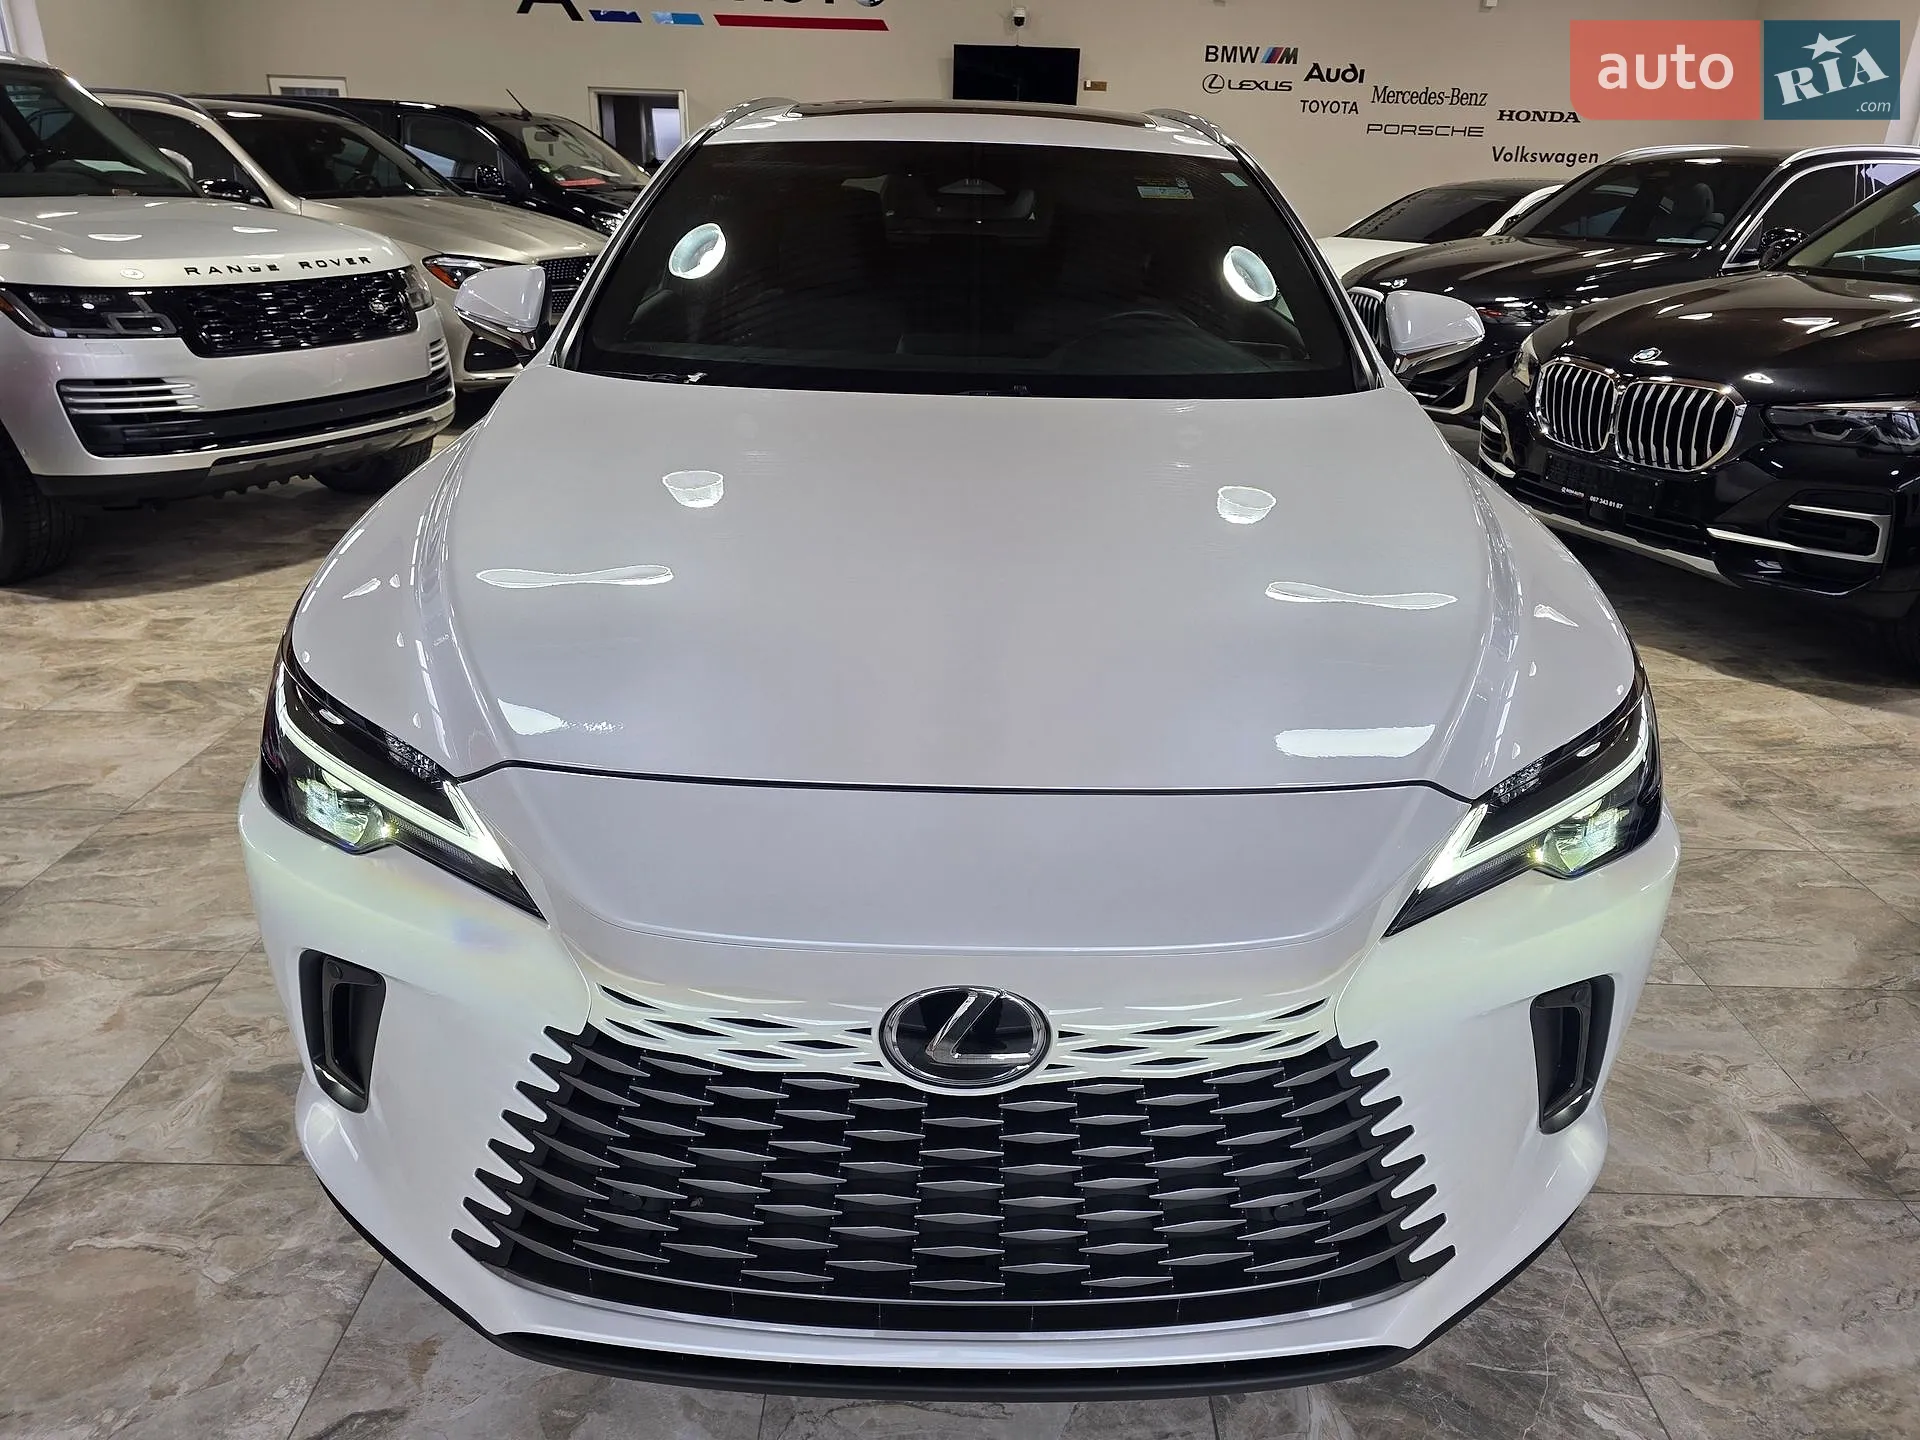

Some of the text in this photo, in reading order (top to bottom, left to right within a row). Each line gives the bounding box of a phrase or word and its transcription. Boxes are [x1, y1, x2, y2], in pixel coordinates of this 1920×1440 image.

[1204, 45, 1260, 64] BMW
[1303, 62, 1366, 84] Audi
[1227, 79, 1293, 92] LEXUS
[1370, 85, 1489, 107] Mercedes-Benz
[1300, 99, 1359, 115] TOYOTA
[1496, 109, 1582, 124] HONDA
[1366, 123, 1485, 138] PORSCHE
[1491, 145, 1599, 168] Volkswagen
[184, 255, 372, 276] RANGE ROVER
